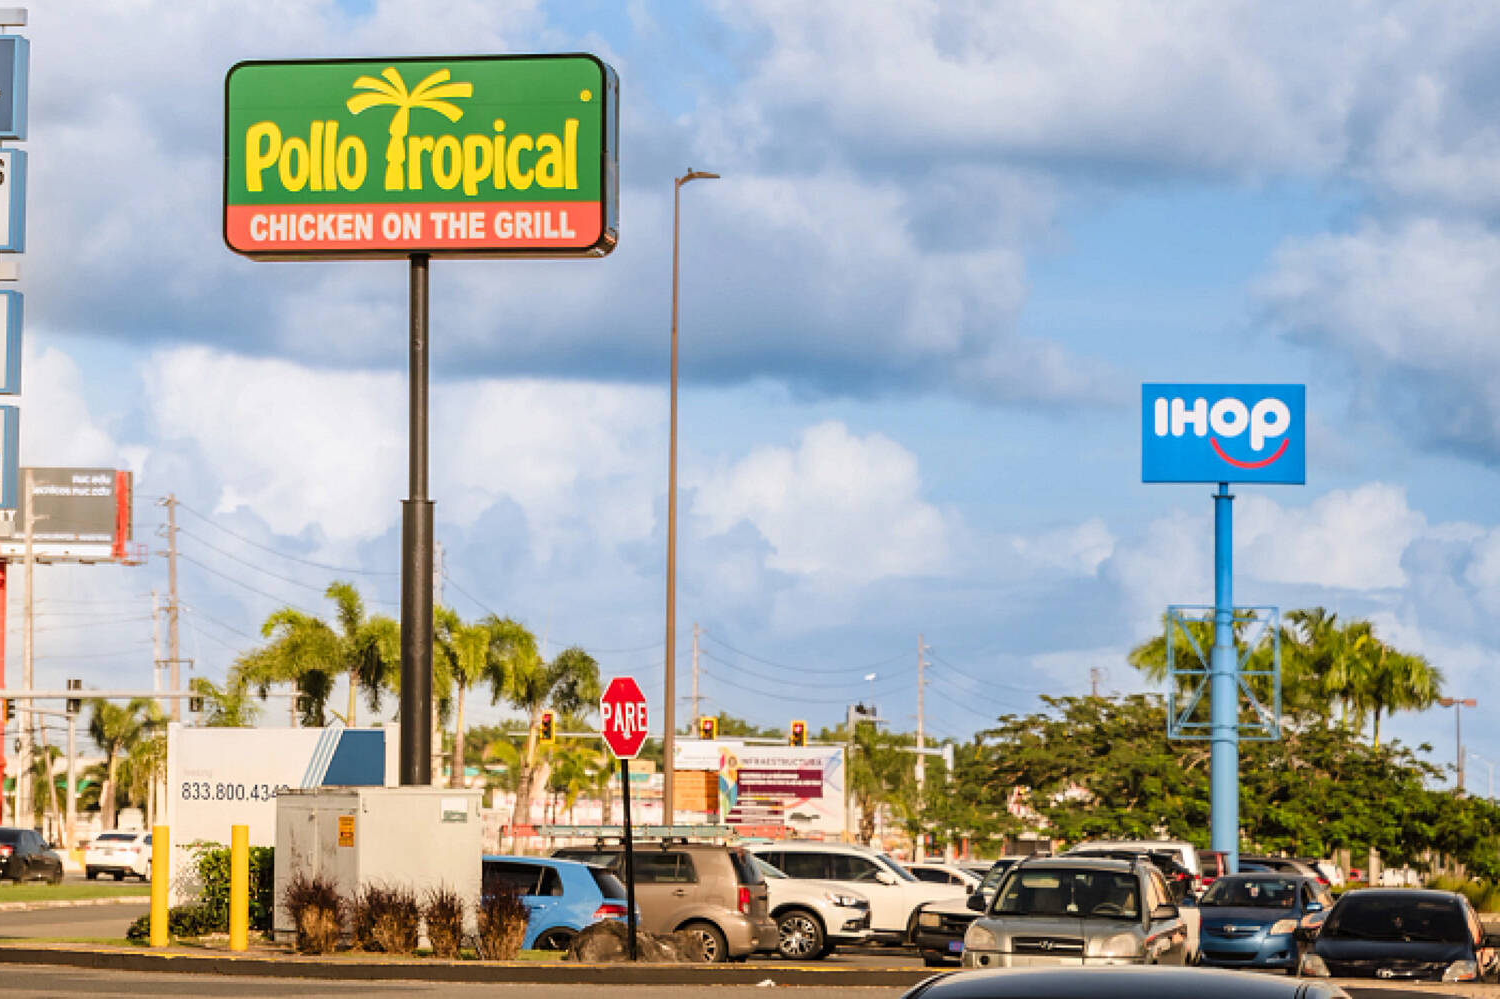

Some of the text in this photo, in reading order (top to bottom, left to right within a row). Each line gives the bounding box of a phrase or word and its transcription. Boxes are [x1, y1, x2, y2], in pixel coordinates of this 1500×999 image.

[245, 120, 368, 192] Pollo
[250, 211, 576, 241] CHICKEN ON THE GRILL
[1154, 398, 1291, 451] IHOP
[601, 703, 647, 731] PARE
